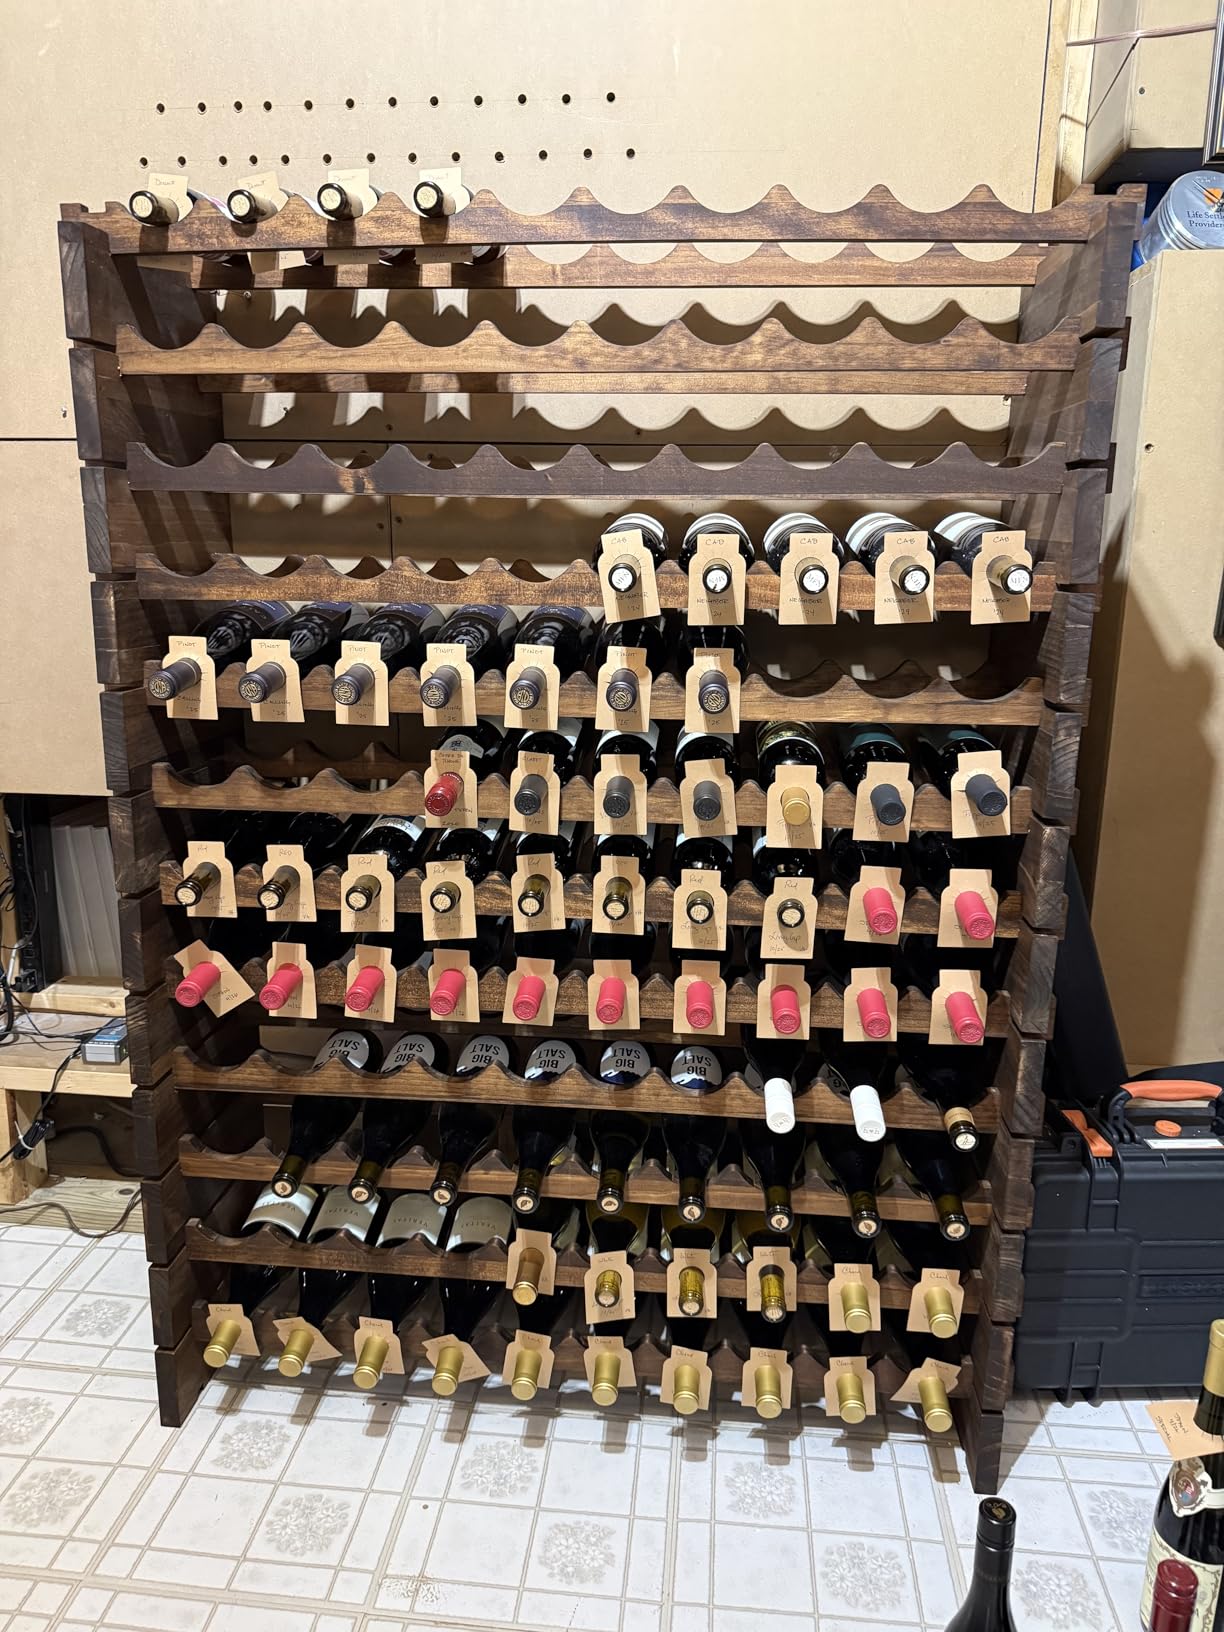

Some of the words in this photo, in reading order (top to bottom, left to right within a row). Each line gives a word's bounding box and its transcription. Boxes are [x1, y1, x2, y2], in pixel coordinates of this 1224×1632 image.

[1186, 210, 1203, 219] Life
[1188, 219, 1224, 228] Provider
[689, 874, 704, 884] Red
[784, 880, 799, 889] Red
[328, 1039, 361, 1051] SALT
[393, 1042, 425, 1055] SALT
[470, 1043, 502, 1056] SALT
[329, 1049, 350, 1058] BIG
[394, 1053, 417, 1063] BIG
[471, 1053, 493, 1065] BIG
[535, 1048, 567, 1060] SALT
[612, 1047, 642, 1060] SALT
[538, 1059, 560, 1069] BIG
[615, 1058, 636, 1069] BIG
[681, 1054, 713, 1067] SALT
[687, 1065, 707, 1076] BIG
